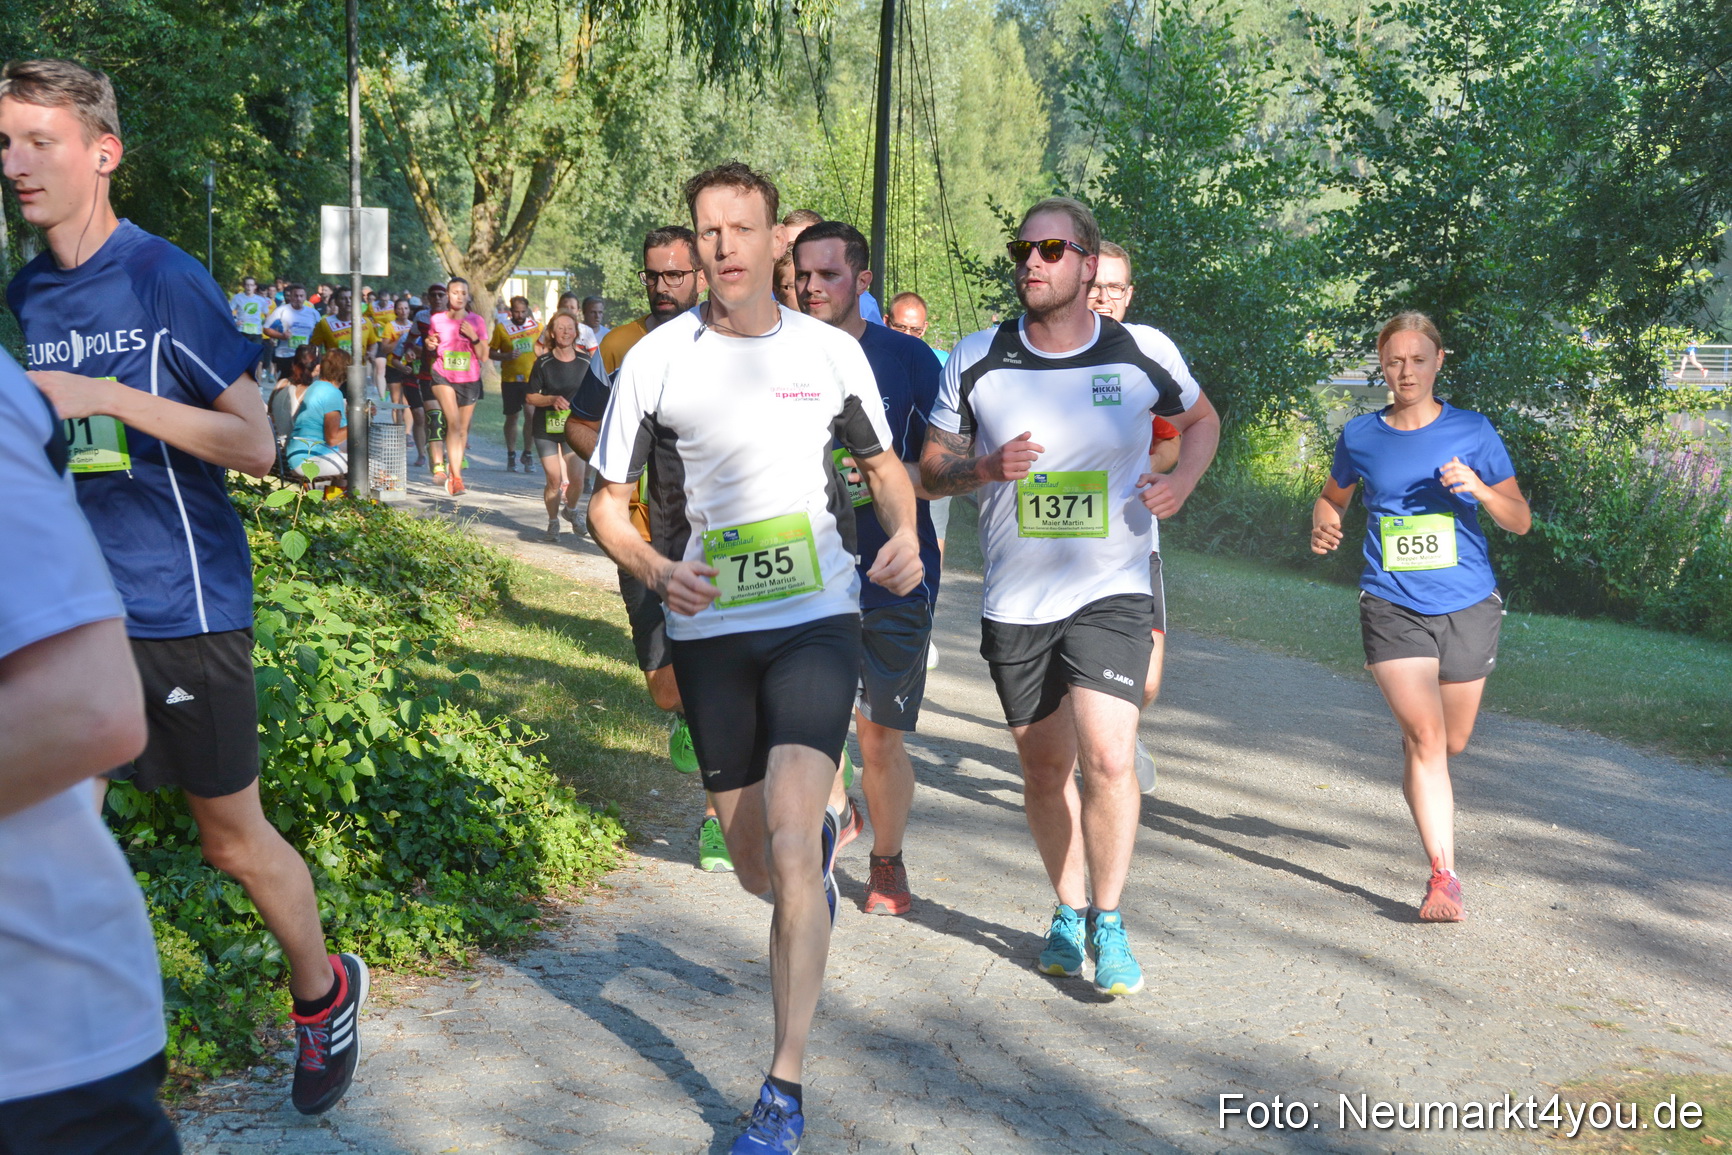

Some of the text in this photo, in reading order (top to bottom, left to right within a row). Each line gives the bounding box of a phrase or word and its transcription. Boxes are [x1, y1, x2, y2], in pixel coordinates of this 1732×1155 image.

[27, 328, 147, 366] EURO POLES
[448, 358, 467, 366] 1437
[782, 391, 821, 399] partner
[1029, 494, 1093, 519] 1371
[717, 536, 754, 549] firmenlauf
[1396, 534, 1439, 555] 658
[730, 546, 794, 583] 755
[731, 589, 766, 601] guttenberger
[767, 585, 787, 595] partner
[788, 581, 805, 589] GmbH
[737, 576, 797, 592] Mandel Marius
[1114, 674, 1134, 686] JAKO
[166, 695, 195, 704] adidas
